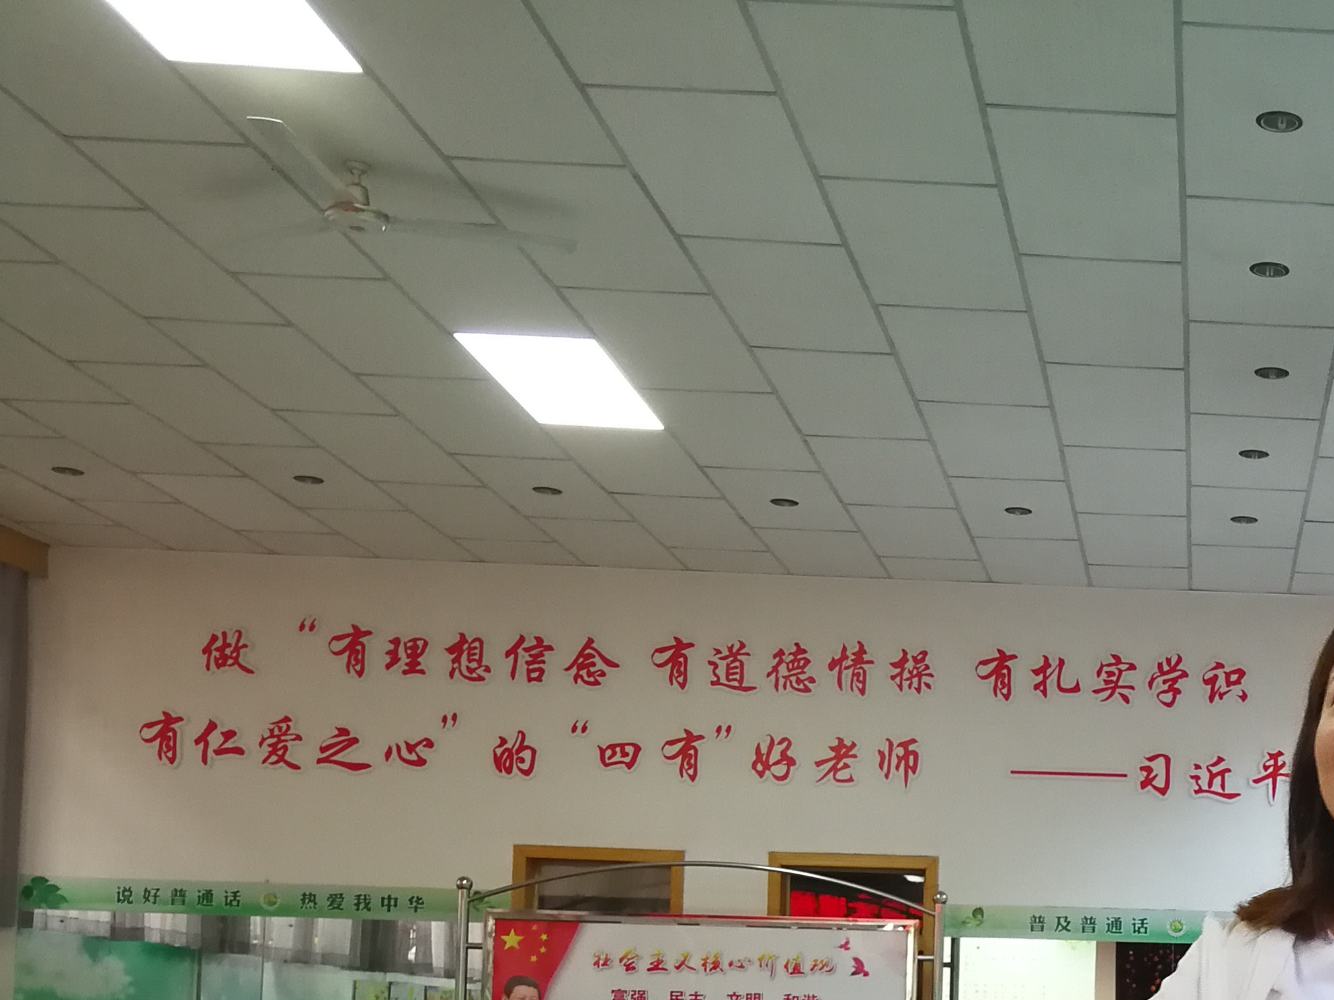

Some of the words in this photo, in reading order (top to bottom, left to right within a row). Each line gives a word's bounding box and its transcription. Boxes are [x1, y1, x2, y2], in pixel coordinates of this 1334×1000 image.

[976, 648, 1250, 709] 有扎实学识
[115, 885, 242, 908] 说好普通话
[299, 891, 426, 913] 热爱我中华
[1029, 913, 1150, 936] 普及普通话
